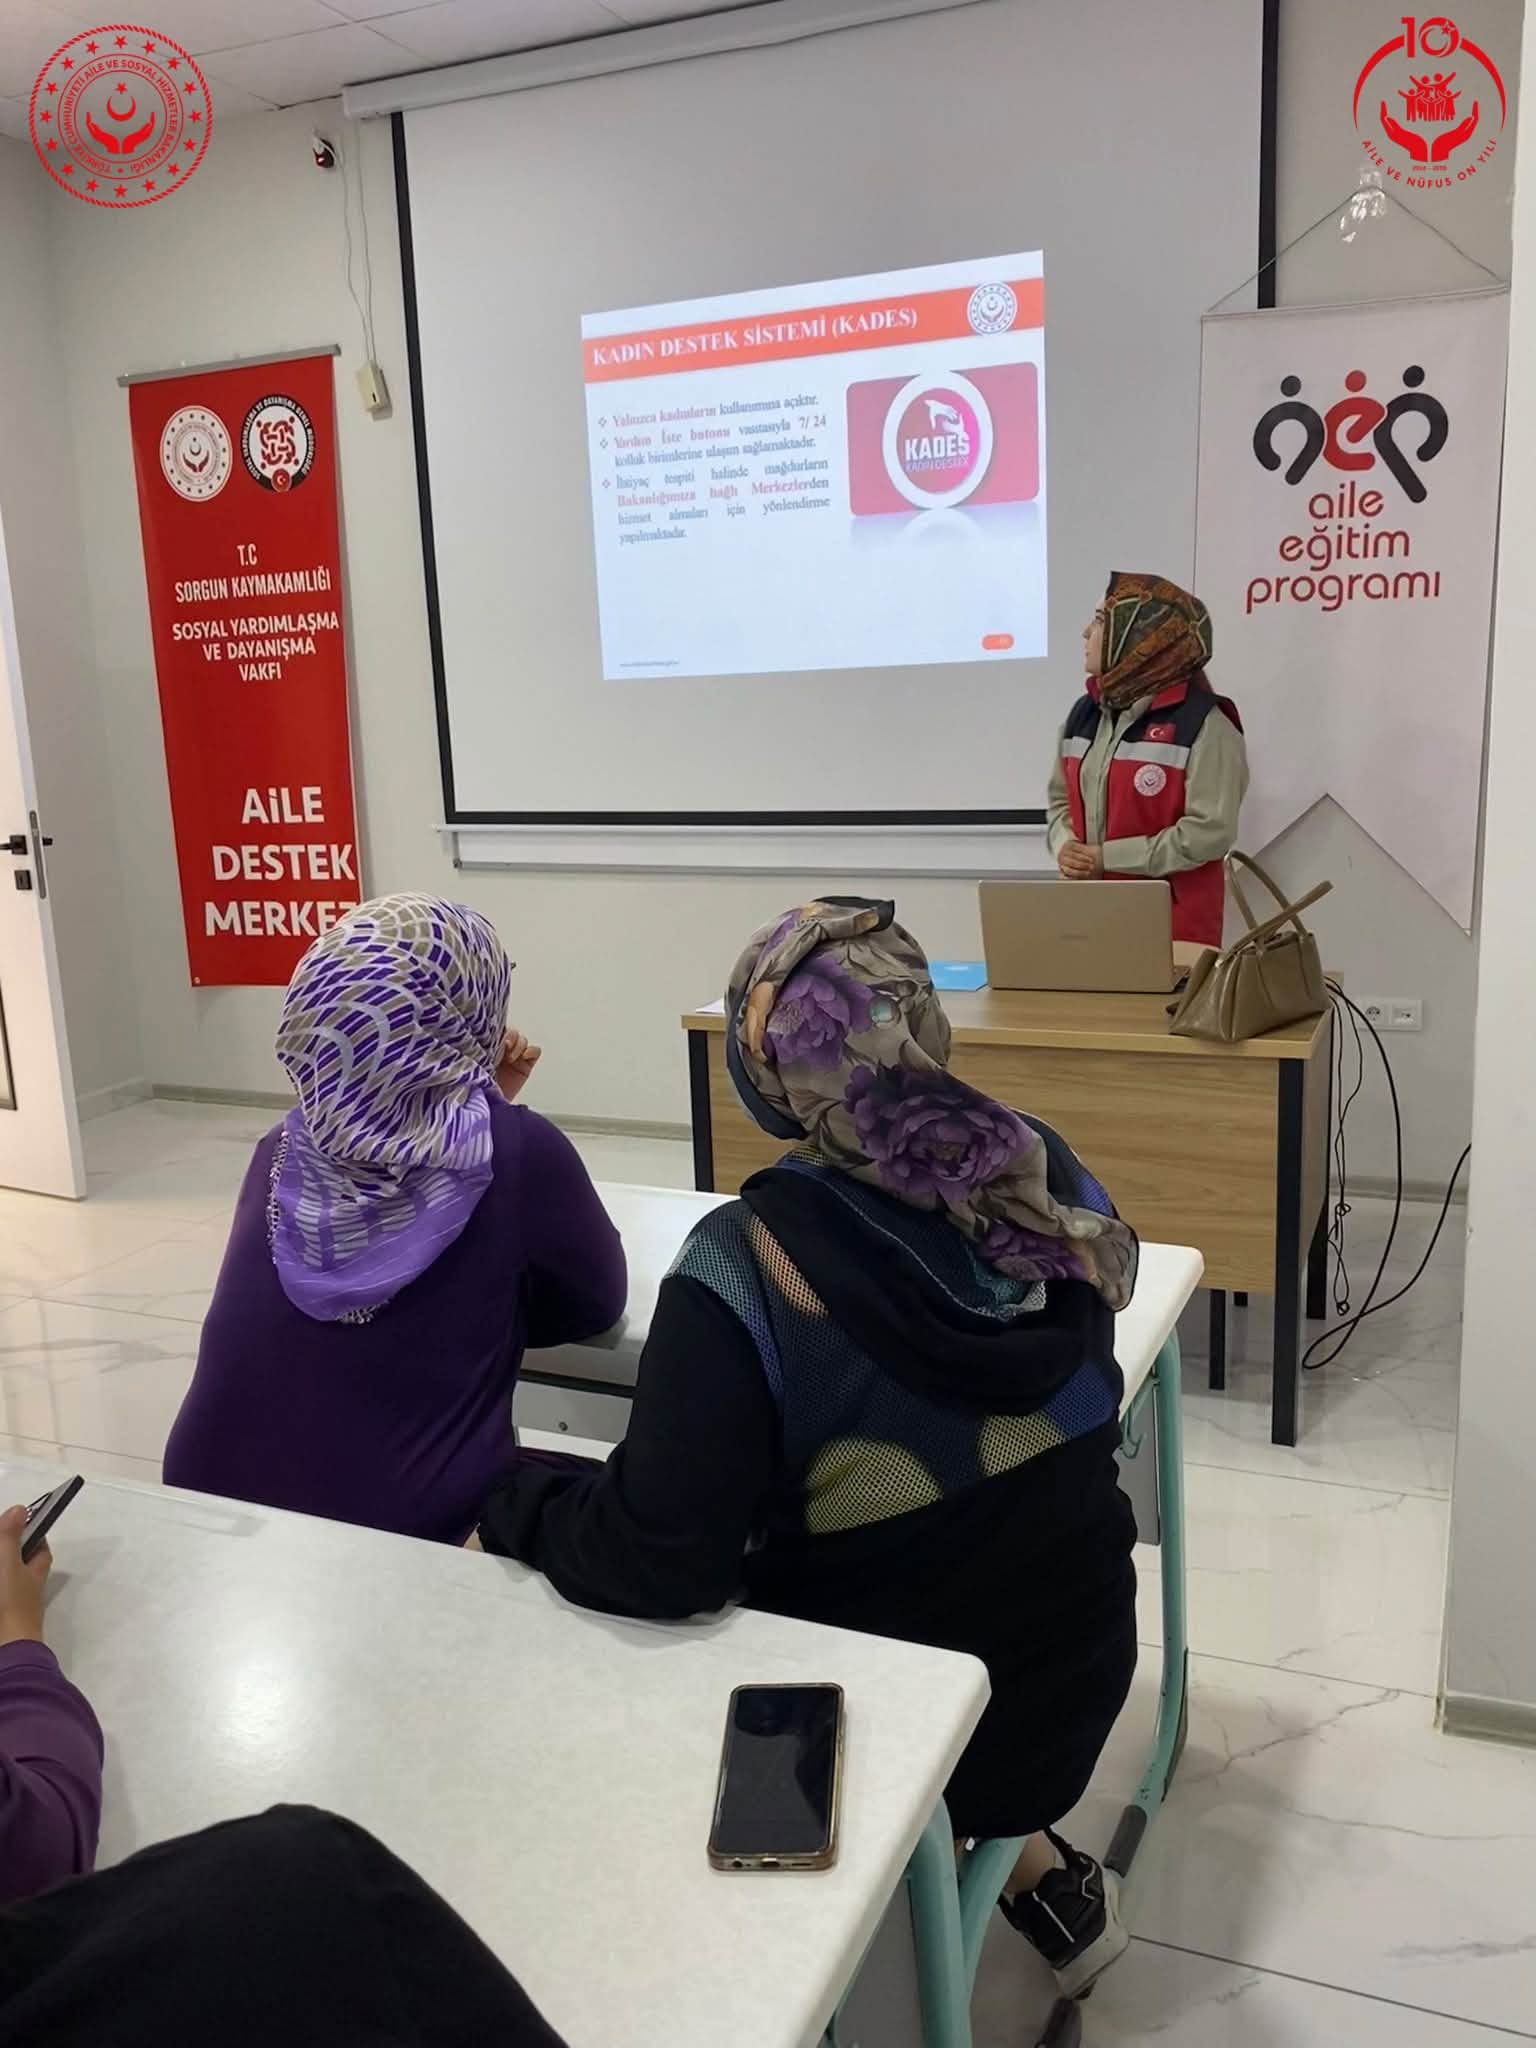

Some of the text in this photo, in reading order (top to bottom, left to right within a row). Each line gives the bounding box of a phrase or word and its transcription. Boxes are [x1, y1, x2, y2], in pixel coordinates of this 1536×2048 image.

[592, 308, 918, 367] KADIN DESTEK SİSTEMİ (KADES)
[814, 413, 827, 427] 24
[905, 434, 970, 461] KADES
[1308, 480, 1384, 520] aile
[237, 543, 258, 566] T.C
[1279, 523, 1410, 572] eğitim
[175, 566, 331, 603] SORGUN KAYMAKAMLIĞI
[1246, 571, 1440, 615] programı
[173, 611, 339, 641] SOSYAL YARDIMLAŞMA
[203, 637, 316, 661] VE DAYANIŞMA
[239, 662, 282, 681] VAKFI
[212, 844, 356, 880] DESTEK
